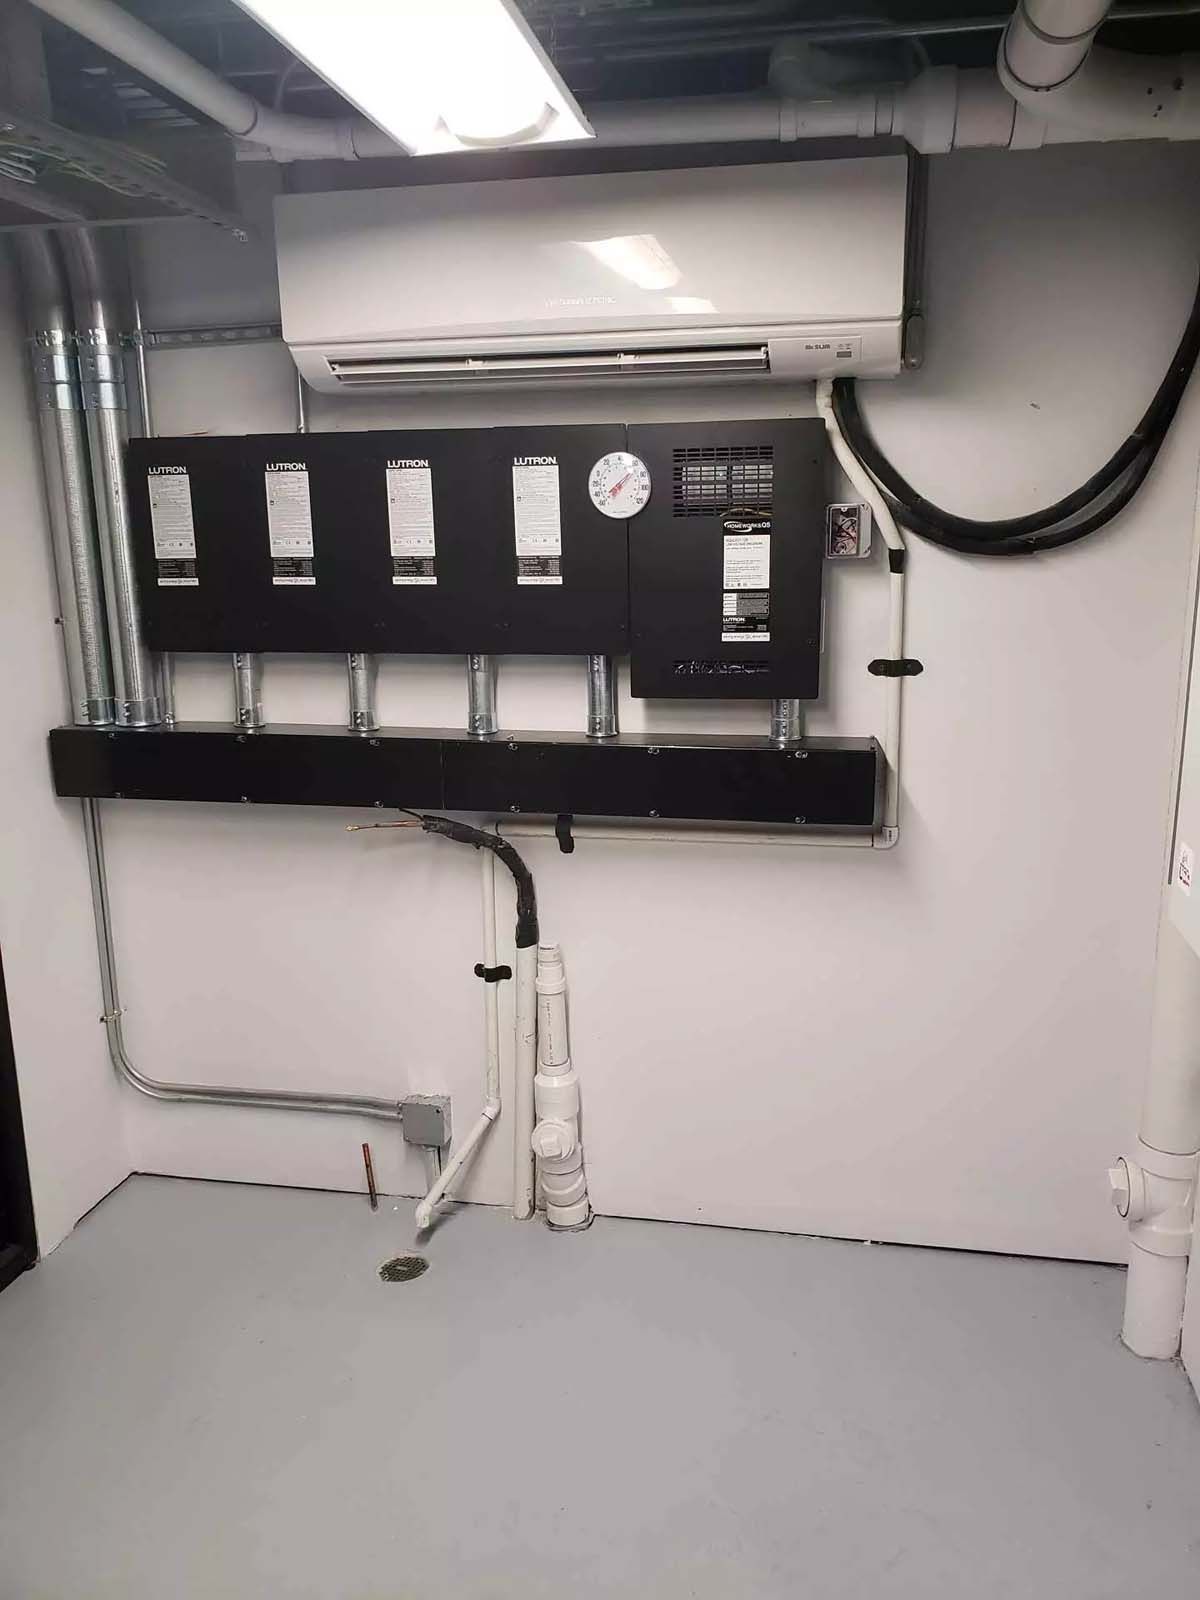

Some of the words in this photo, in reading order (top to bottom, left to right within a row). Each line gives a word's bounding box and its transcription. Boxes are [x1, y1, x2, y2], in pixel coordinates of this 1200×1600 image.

[387, 459, 429, 468] LUTRON
[513, 456, 557, 465] LUTRON
[148, 466, 187, 475] LUTRON
[266, 462, 306, 471] LUTRON
